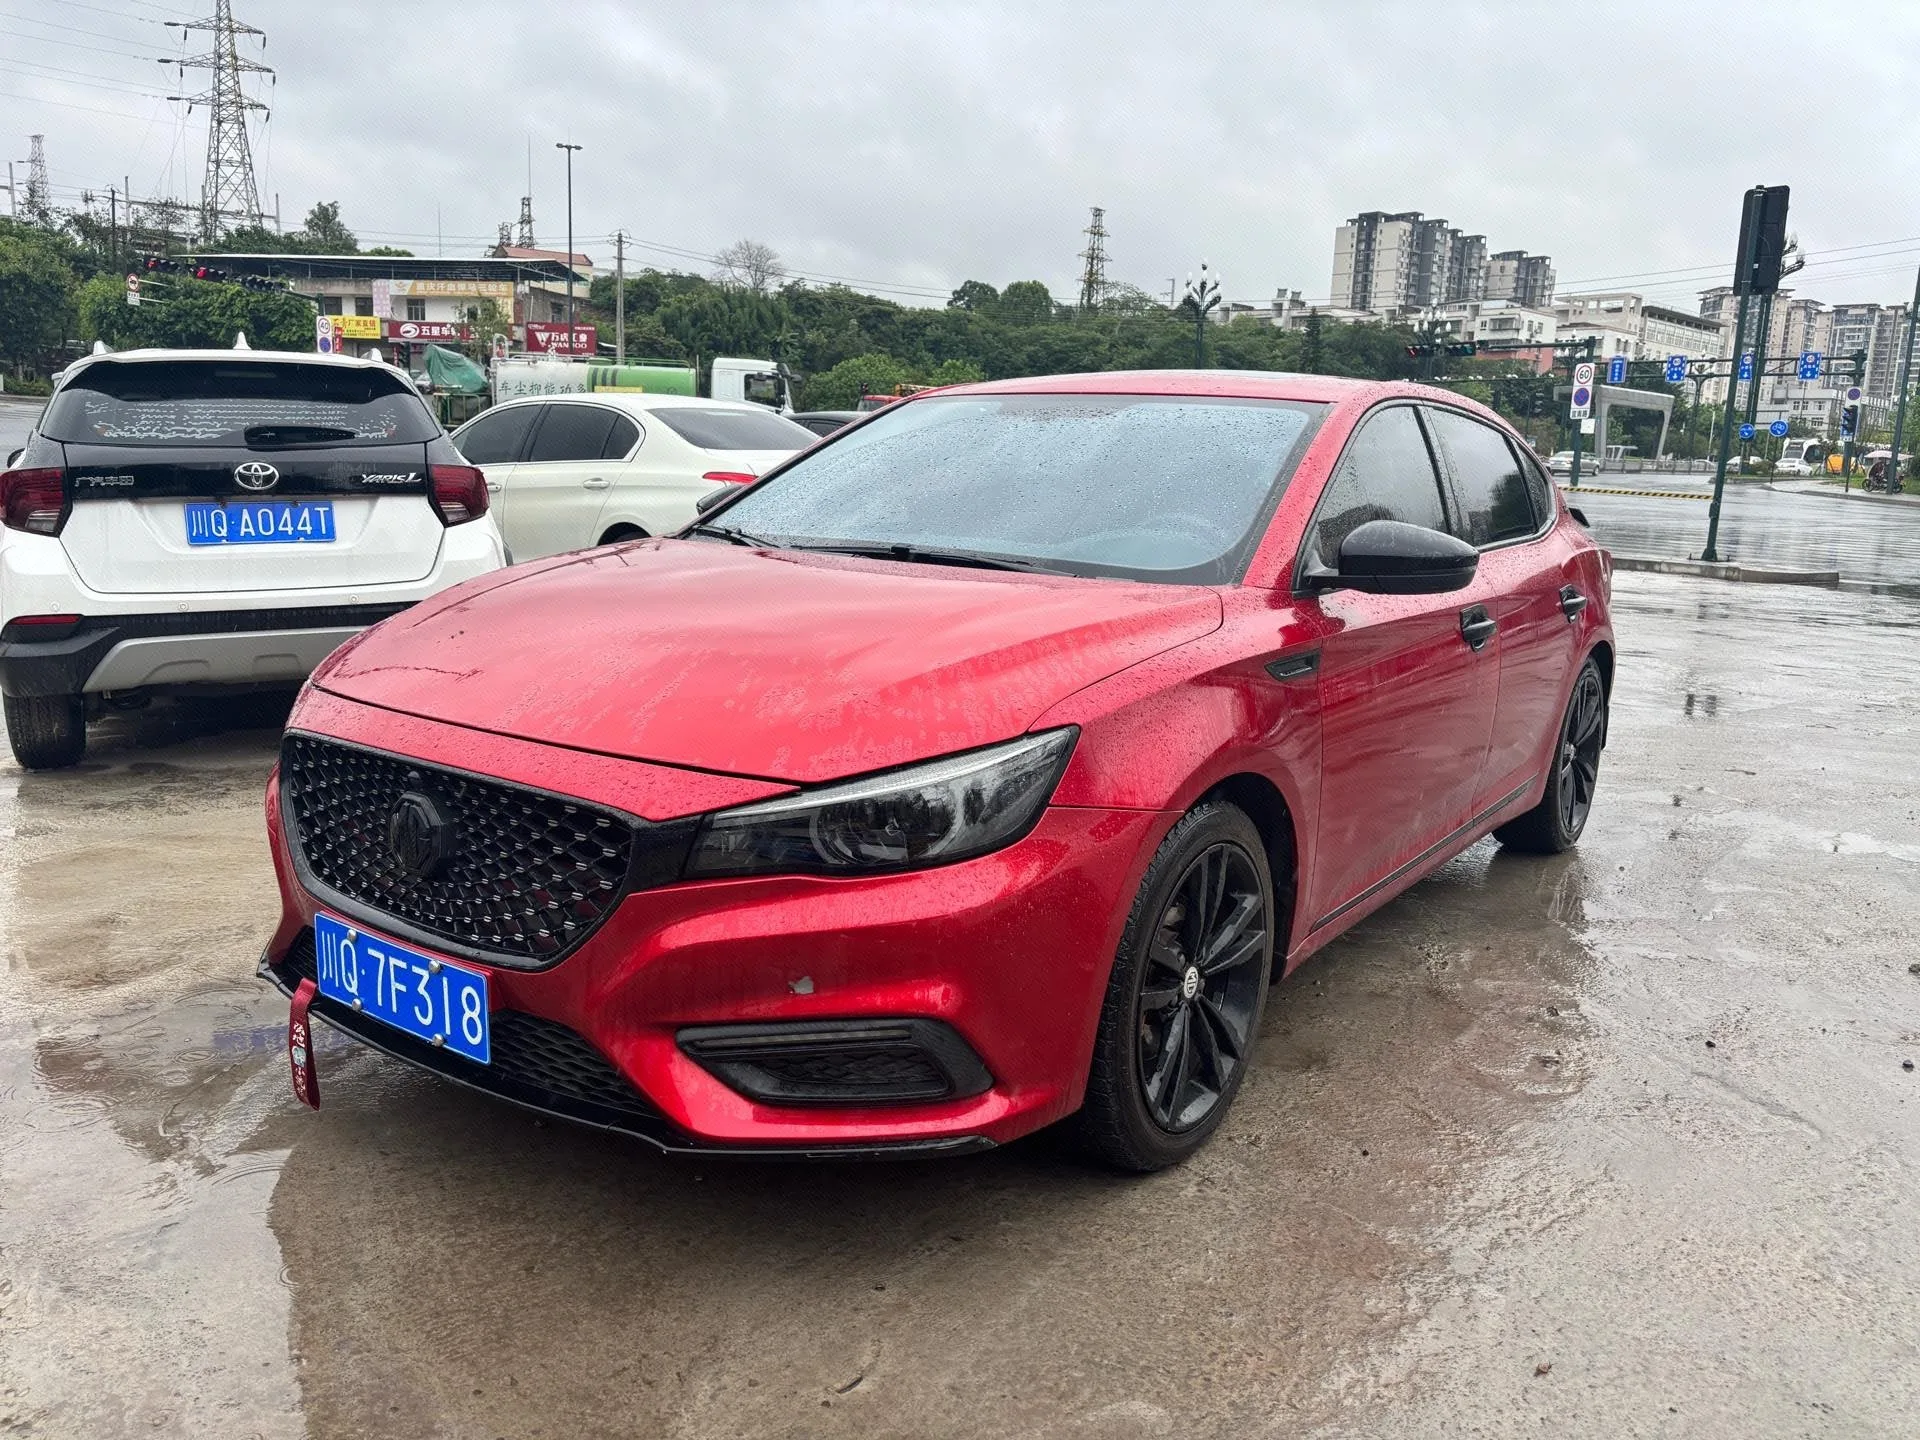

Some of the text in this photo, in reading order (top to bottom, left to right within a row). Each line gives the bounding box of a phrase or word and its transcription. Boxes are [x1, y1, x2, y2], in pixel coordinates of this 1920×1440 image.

[320, 321, 329, 330] 40
[1579, 369, 1590, 380] 60
[361, 474, 406, 484] YARIS
[192, 507, 330, 538] 川Q·A044T
[321, 930, 483, 1046] 川Q·7F318
